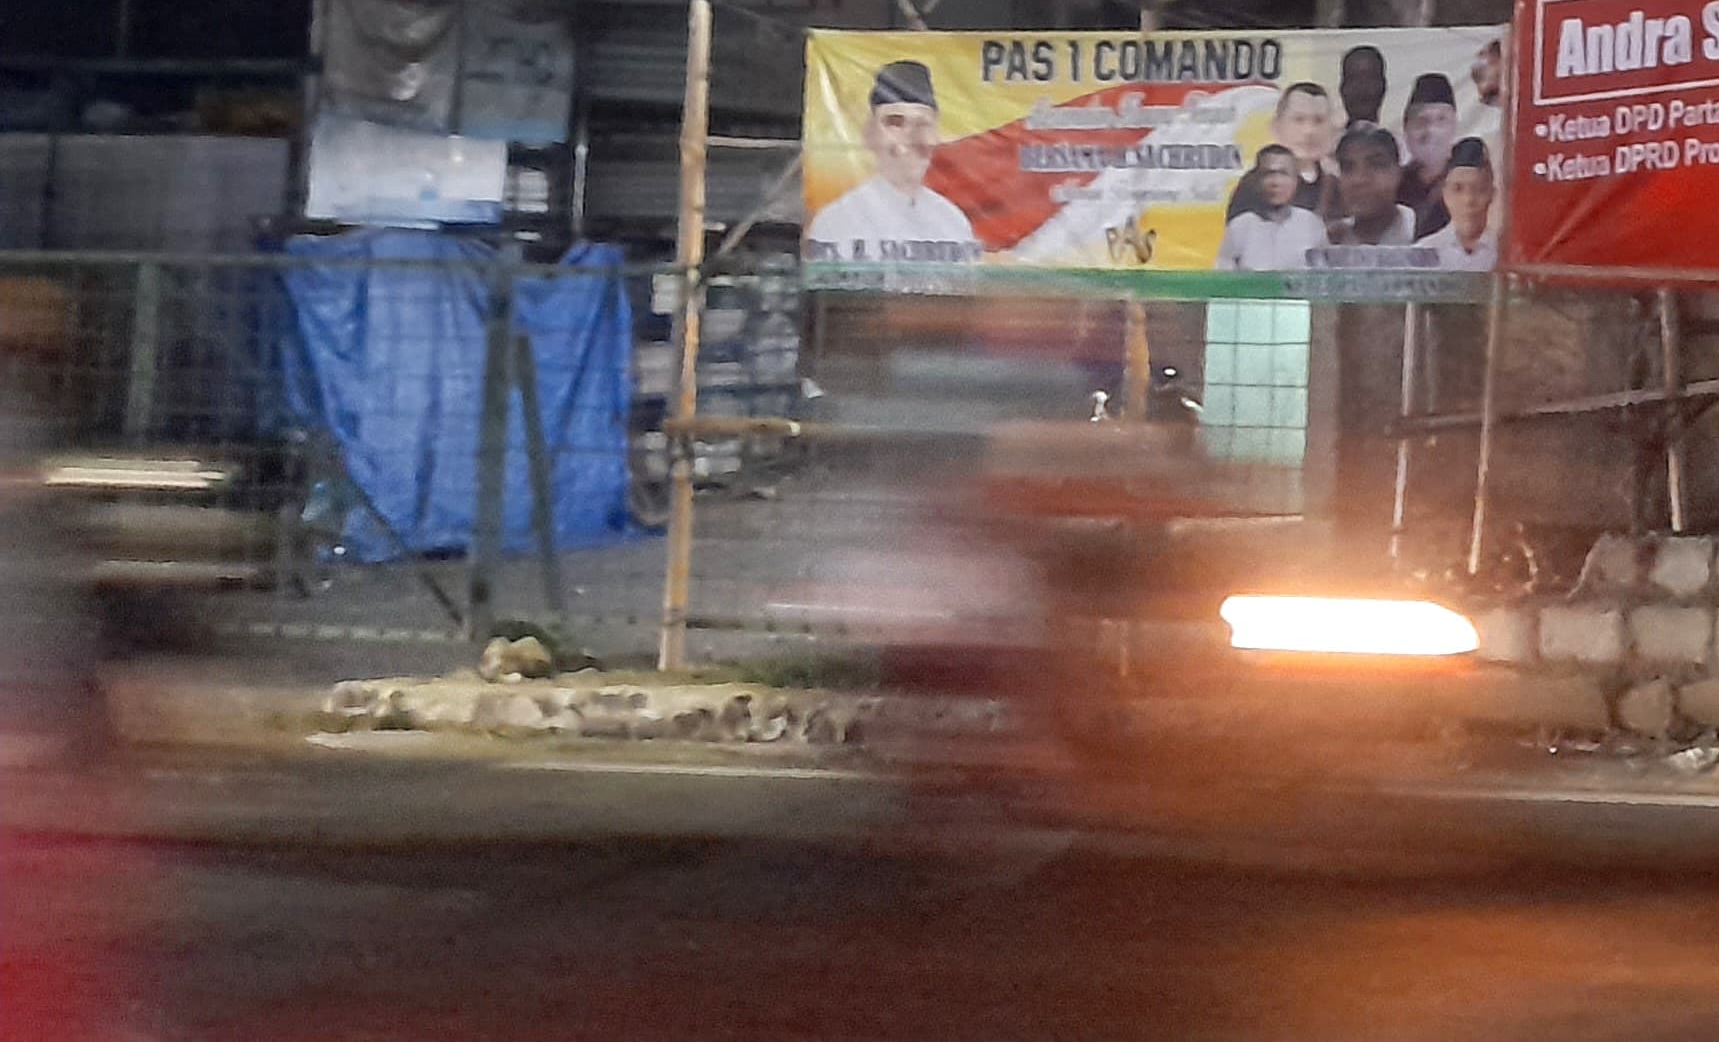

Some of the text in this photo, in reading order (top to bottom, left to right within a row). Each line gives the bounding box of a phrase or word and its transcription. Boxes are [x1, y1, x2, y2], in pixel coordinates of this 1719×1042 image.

[981, 40, 1054, 82] PAS
[1093, 39, 1282, 81] COMANDO
[1555, 10, 1693, 78] Andra
[1548, 113, 1611, 144] Ketua
[1615, 101, 1665, 135] DPD
[1546, 154, 1610, 183] Ketua
[1616, 142, 1679, 174] DPRD
